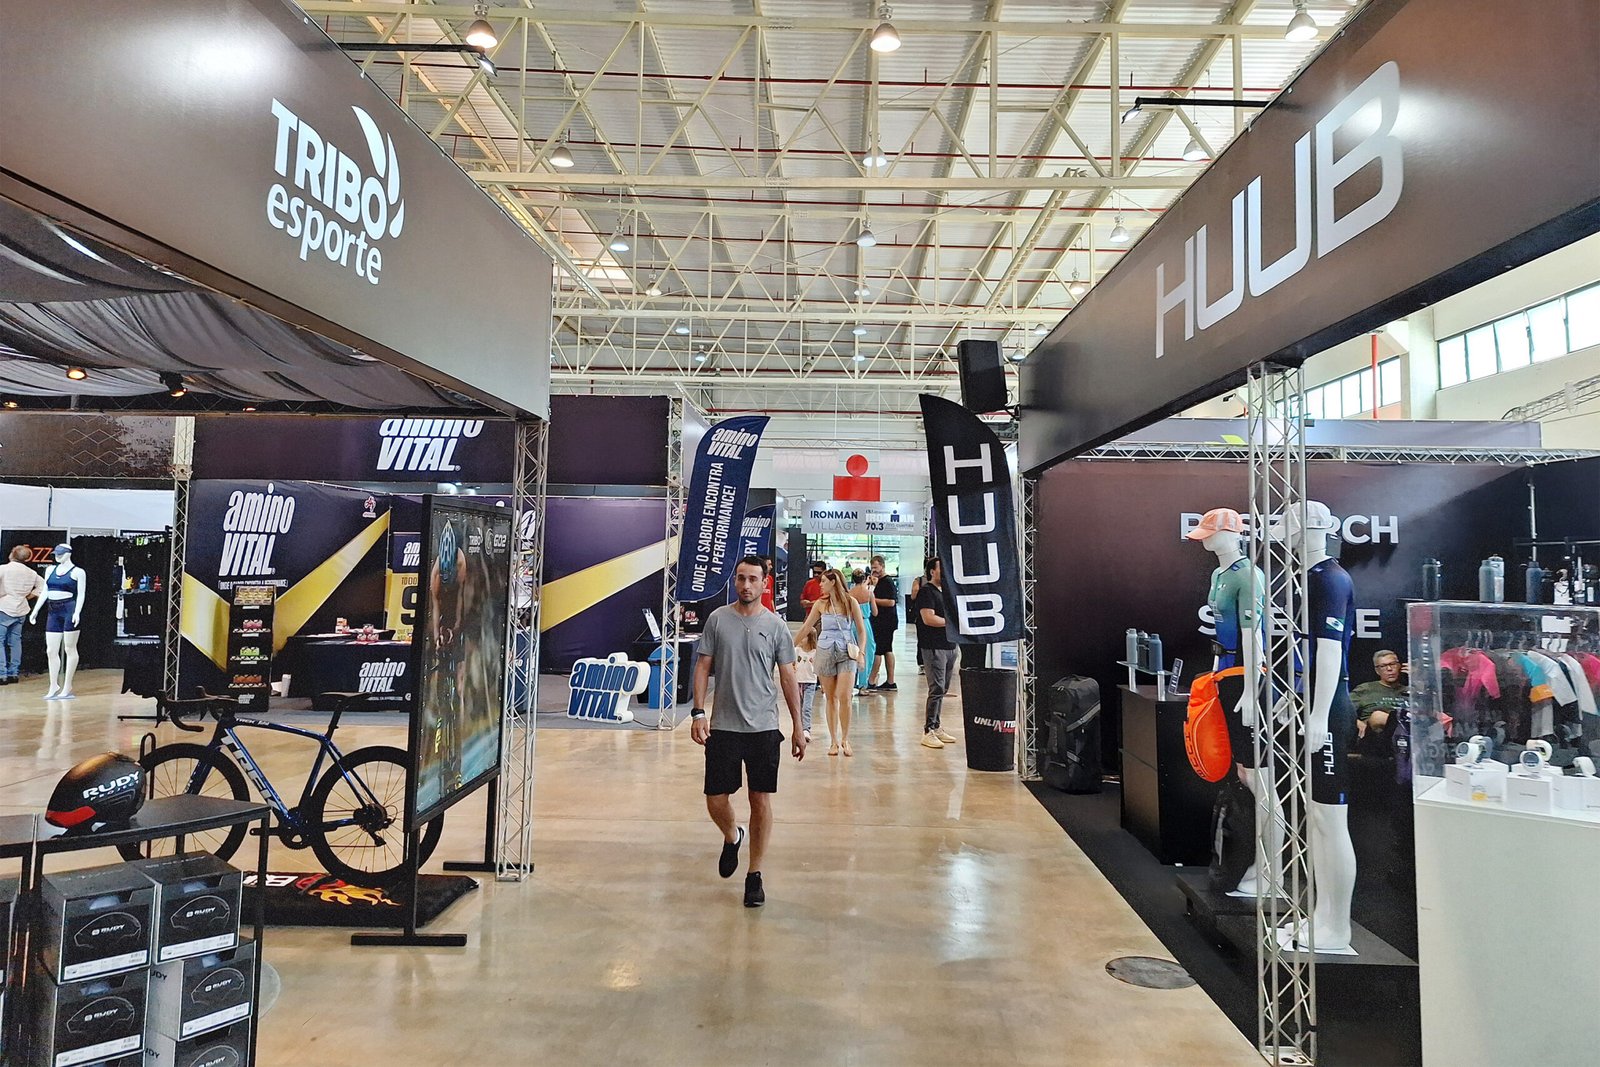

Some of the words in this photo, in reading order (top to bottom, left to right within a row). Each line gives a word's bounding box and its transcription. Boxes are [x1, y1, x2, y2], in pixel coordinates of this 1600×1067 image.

[271, 97, 388, 241] TRIBO
[1156, 60, 1404, 359] HUUB
[266, 183, 382, 285] esporte
[707, 441, 742, 460] VITAL
[711, 428, 758, 447] amino
[703, 462, 724, 516] ENCONTRA
[223, 482, 296, 534] amino
[742, 515, 771, 528] amino
[810, 510, 858, 519] IRONMAN
[698, 518, 714, 553] SABOR
[711, 485, 737, 565] PERFORMANCE!
[809, 521, 858, 530] VILLAGE
[943, 443, 1005, 635] HUUB
[218, 533, 272, 576] VITAL
[700, 553, 709, 562] O
[691, 563, 707, 592] ONDE
[711, 567, 722, 575] A
[359, 657, 406, 677] amino
[570, 656, 639, 692] amino
[568, 689, 618, 720] VITAL
[82, 771, 139, 799] RUDY
[194, 907, 216, 915] RUDY
[100, 924, 125, 934] RUDY
[212, 979, 232, 989] RUDY
[94, 1008, 119, 1018] RUDY
